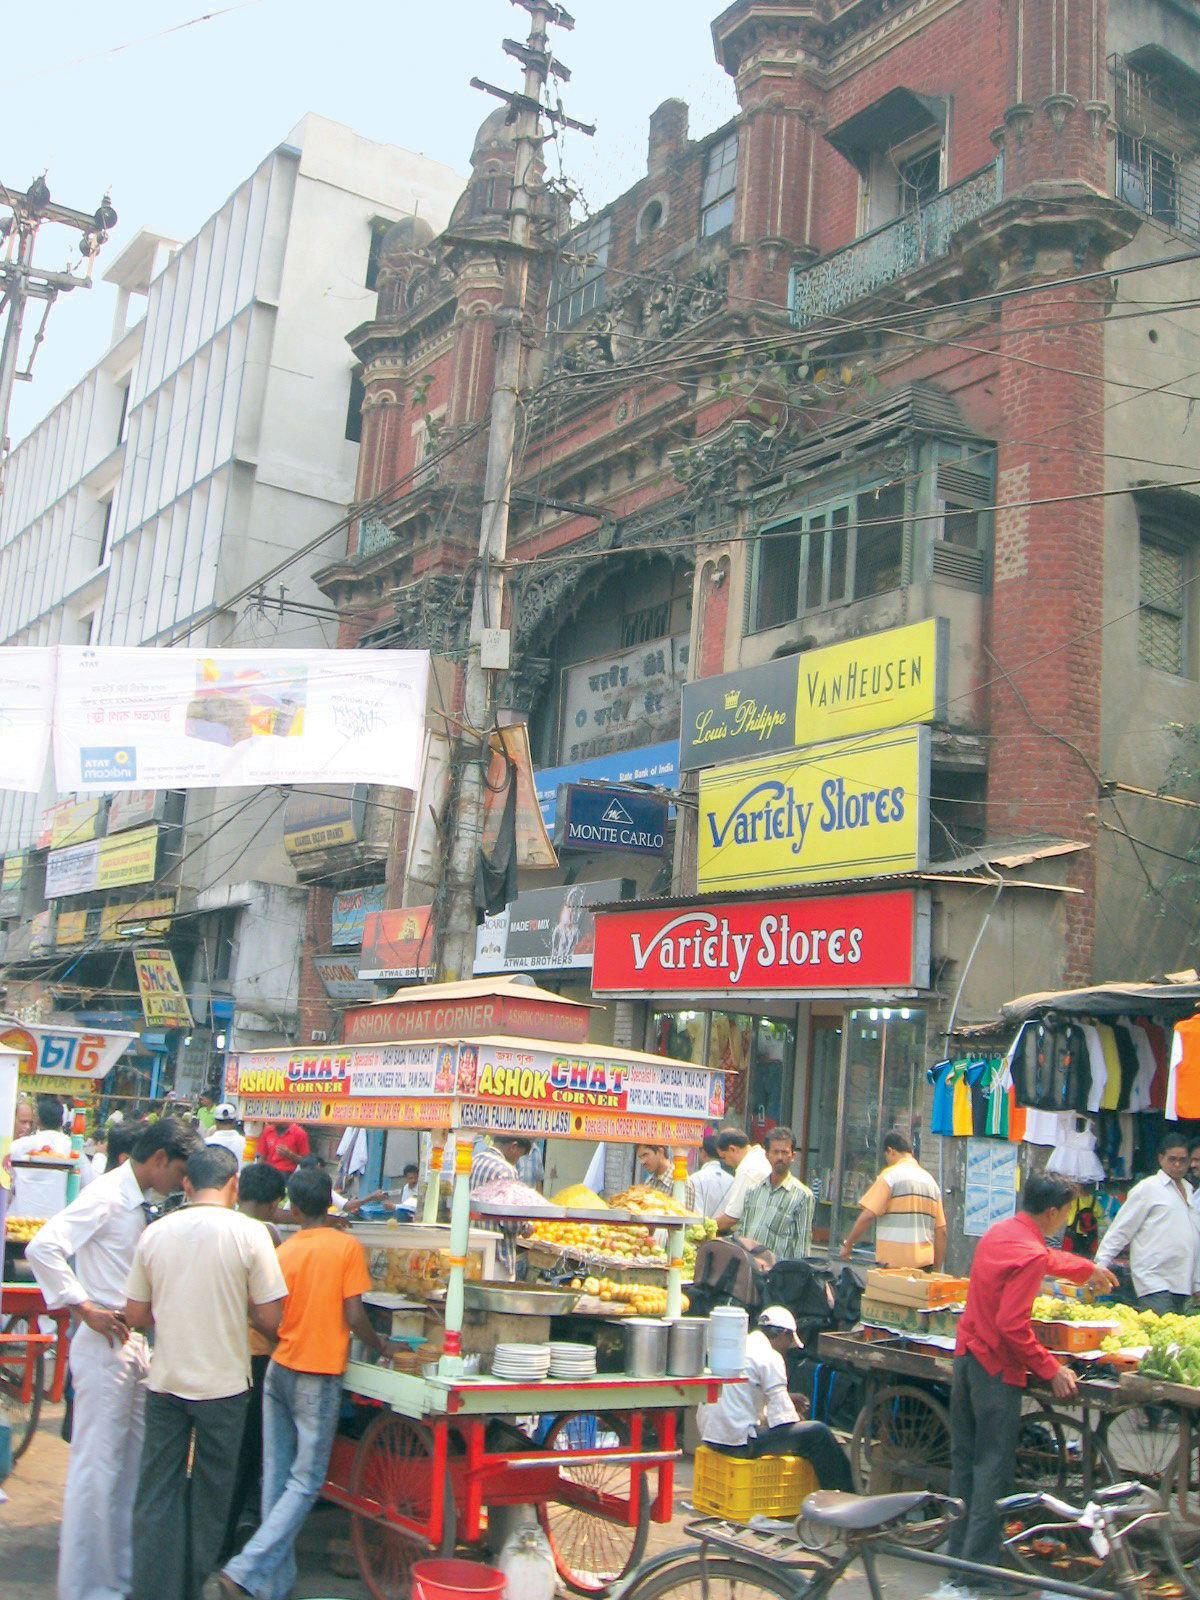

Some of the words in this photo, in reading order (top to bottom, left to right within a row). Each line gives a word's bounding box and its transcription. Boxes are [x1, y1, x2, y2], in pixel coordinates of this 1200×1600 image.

[692, 709, 727, 745] Louis
[731, 700, 787, 739] Philippe
[634, 768, 650, 779] Bank
[650, 766, 658, 776] of
[658, 763, 674, 775] India
[707, 781, 813, 854] Variety
[820, 777, 905, 833] Stores
[569, 823, 618, 844] MONTE
[620, 829, 664, 848] CARLO
[503, 958, 529, 968] ATWAL
[531, 955, 573, 967] BROTHERS
[631, 912, 753, 983] Variety
[757, 914, 864, 967] Stores
[379, 969, 403, 978] ATWAL
[351, 1012, 393, 1037] ASHOK
[396, 1008, 430, 1035] CHAT
[434, 1003, 494, 1031] CORNER
[40, 1034, 106, 1072] চাট
[287, 1052, 352, 1081] CHAT
[239, 1066, 287, 1093] ASHOK
[288, 1081, 343, 1094] CORNER
[478, 1063, 550, 1100] ASHOK
[550, 1056, 629, 1094] CHAT
[551, 1089, 619, 1108] CORNER
[461, 1102, 490, 1127] KESARIA
[491, 1105, 517, 1130] FALUDA
[518, 1108, 544, 1132] COOLFI
[544, 1111, 550, 1132] &
[550, 1110, 572, 1134] LASSI
